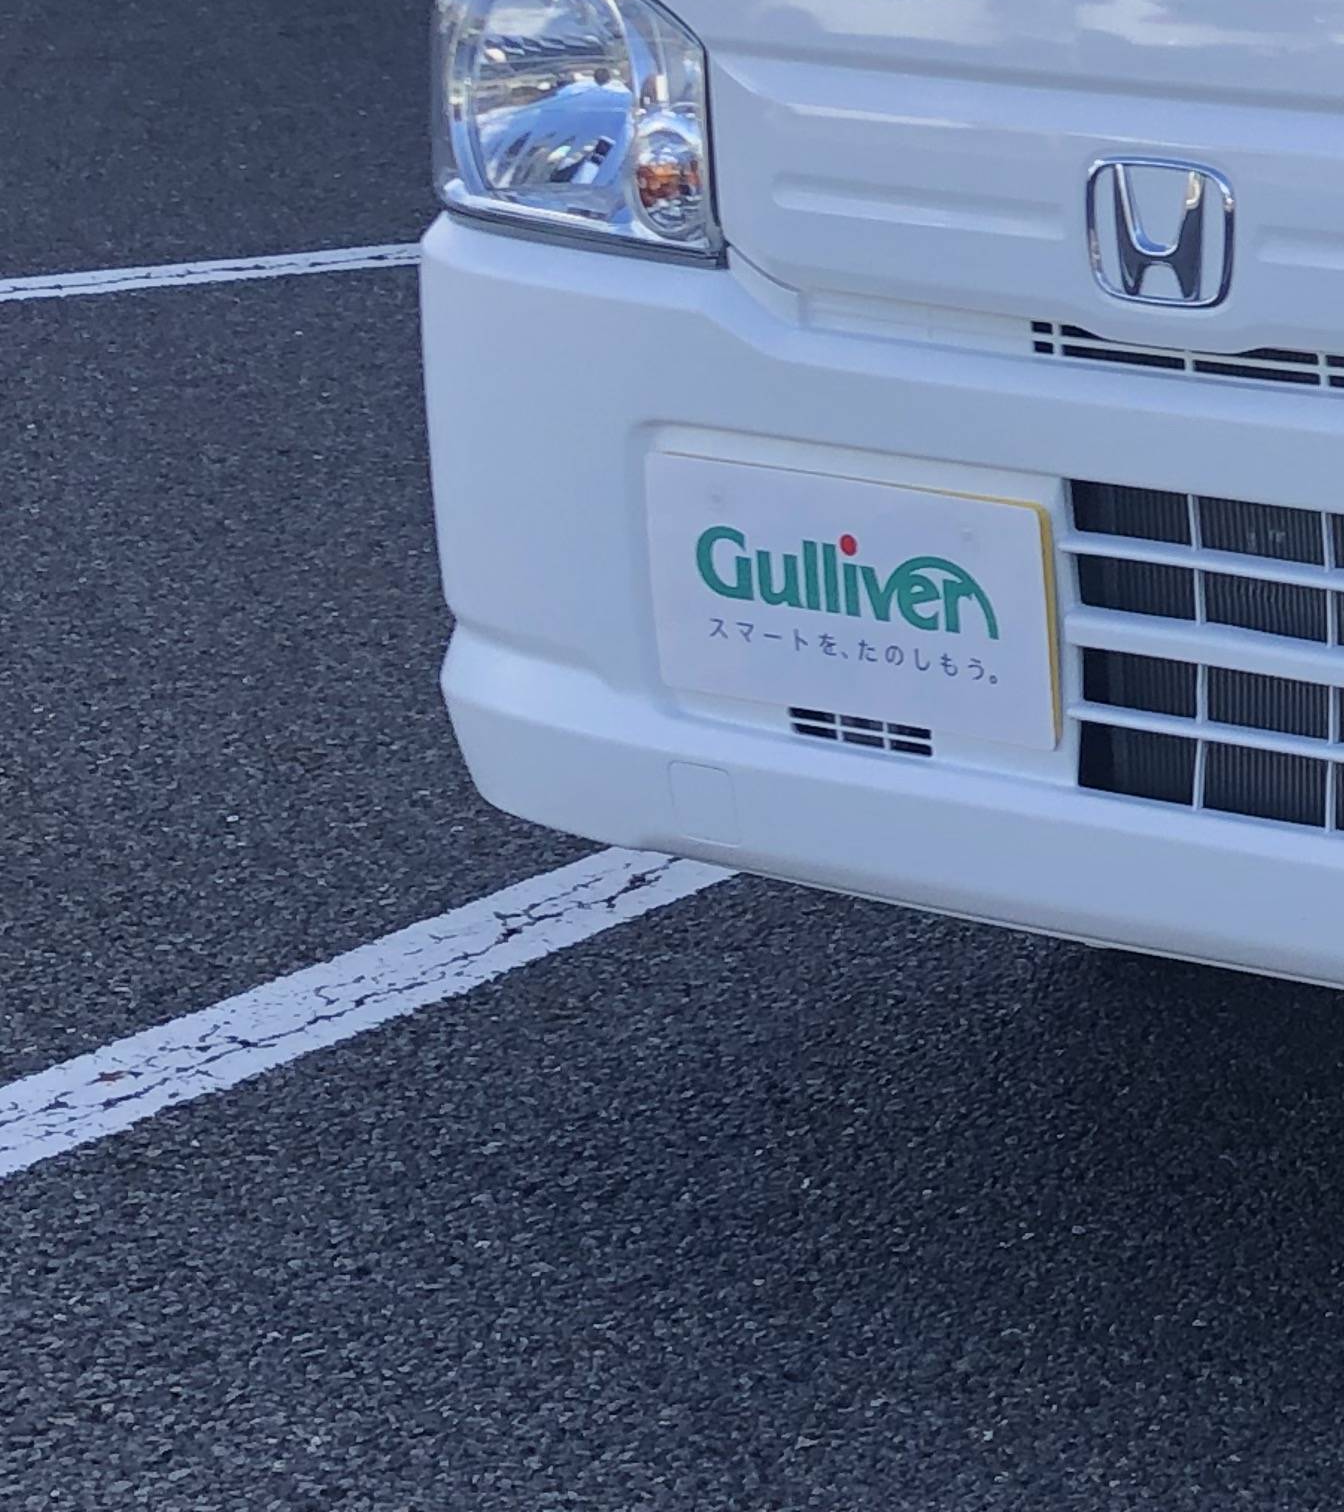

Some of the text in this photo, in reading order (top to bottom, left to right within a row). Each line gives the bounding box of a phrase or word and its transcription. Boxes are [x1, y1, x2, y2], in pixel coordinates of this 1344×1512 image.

[694, 524, 1000, 641] Gulliver
[708, 617, 999, 686] スマートを、たのしもう。
